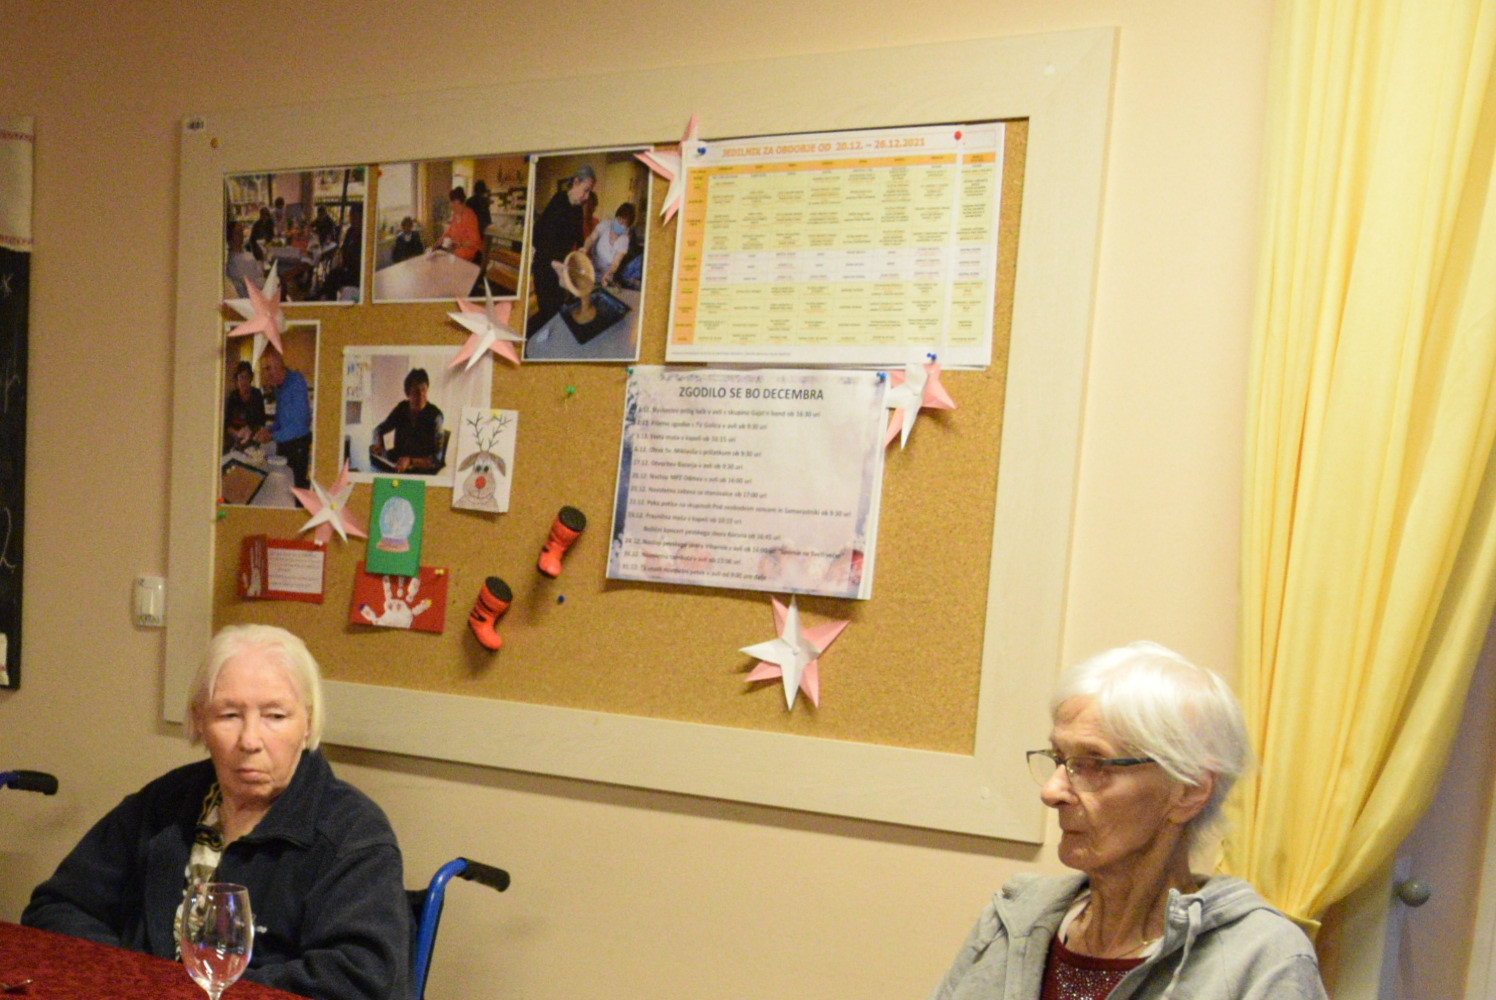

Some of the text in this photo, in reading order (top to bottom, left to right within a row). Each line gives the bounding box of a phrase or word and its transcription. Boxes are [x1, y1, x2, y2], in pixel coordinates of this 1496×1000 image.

[679, 387, 824, 400] ZGODILO SE BO DECEMBRA
